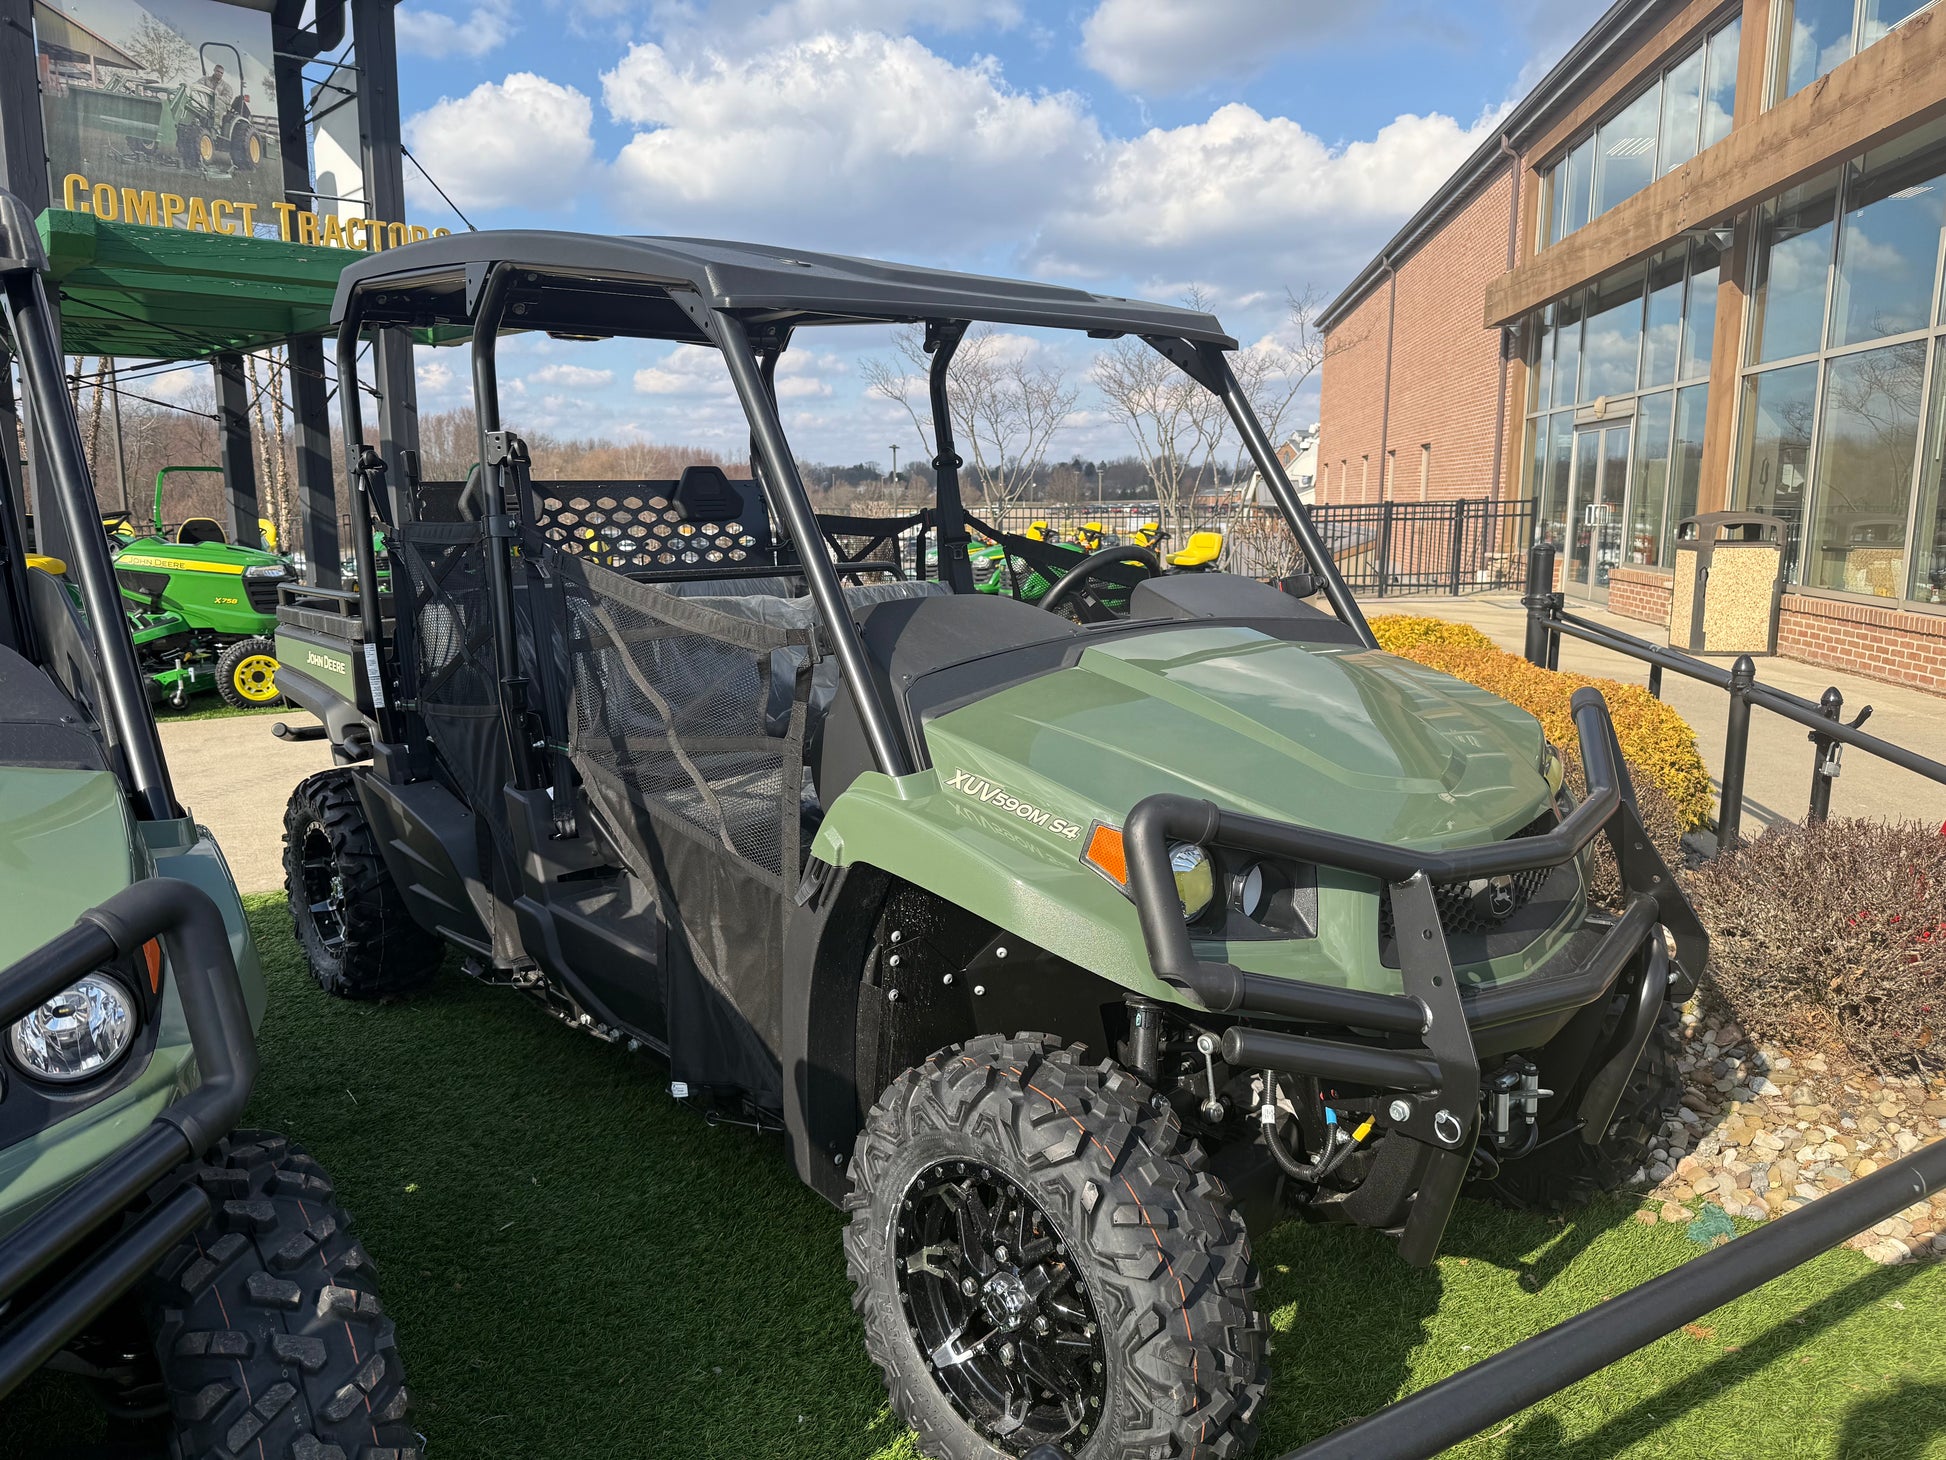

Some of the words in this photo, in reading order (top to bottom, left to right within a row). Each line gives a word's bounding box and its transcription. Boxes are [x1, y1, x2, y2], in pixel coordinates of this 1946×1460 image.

[63, 173, 258, 238] COMPACT
[271, 201, 452, 253] TRACTO
[128, 556, 153, 566] JOHN
[154, 559, 186, 569] DEERE
[307, 650, 324, 668] JOHN
[323, 654, 346, 675] DEERE
[944, 768, 1051, 828] XUV590M
[1047, 818, 1082, 841] S4
